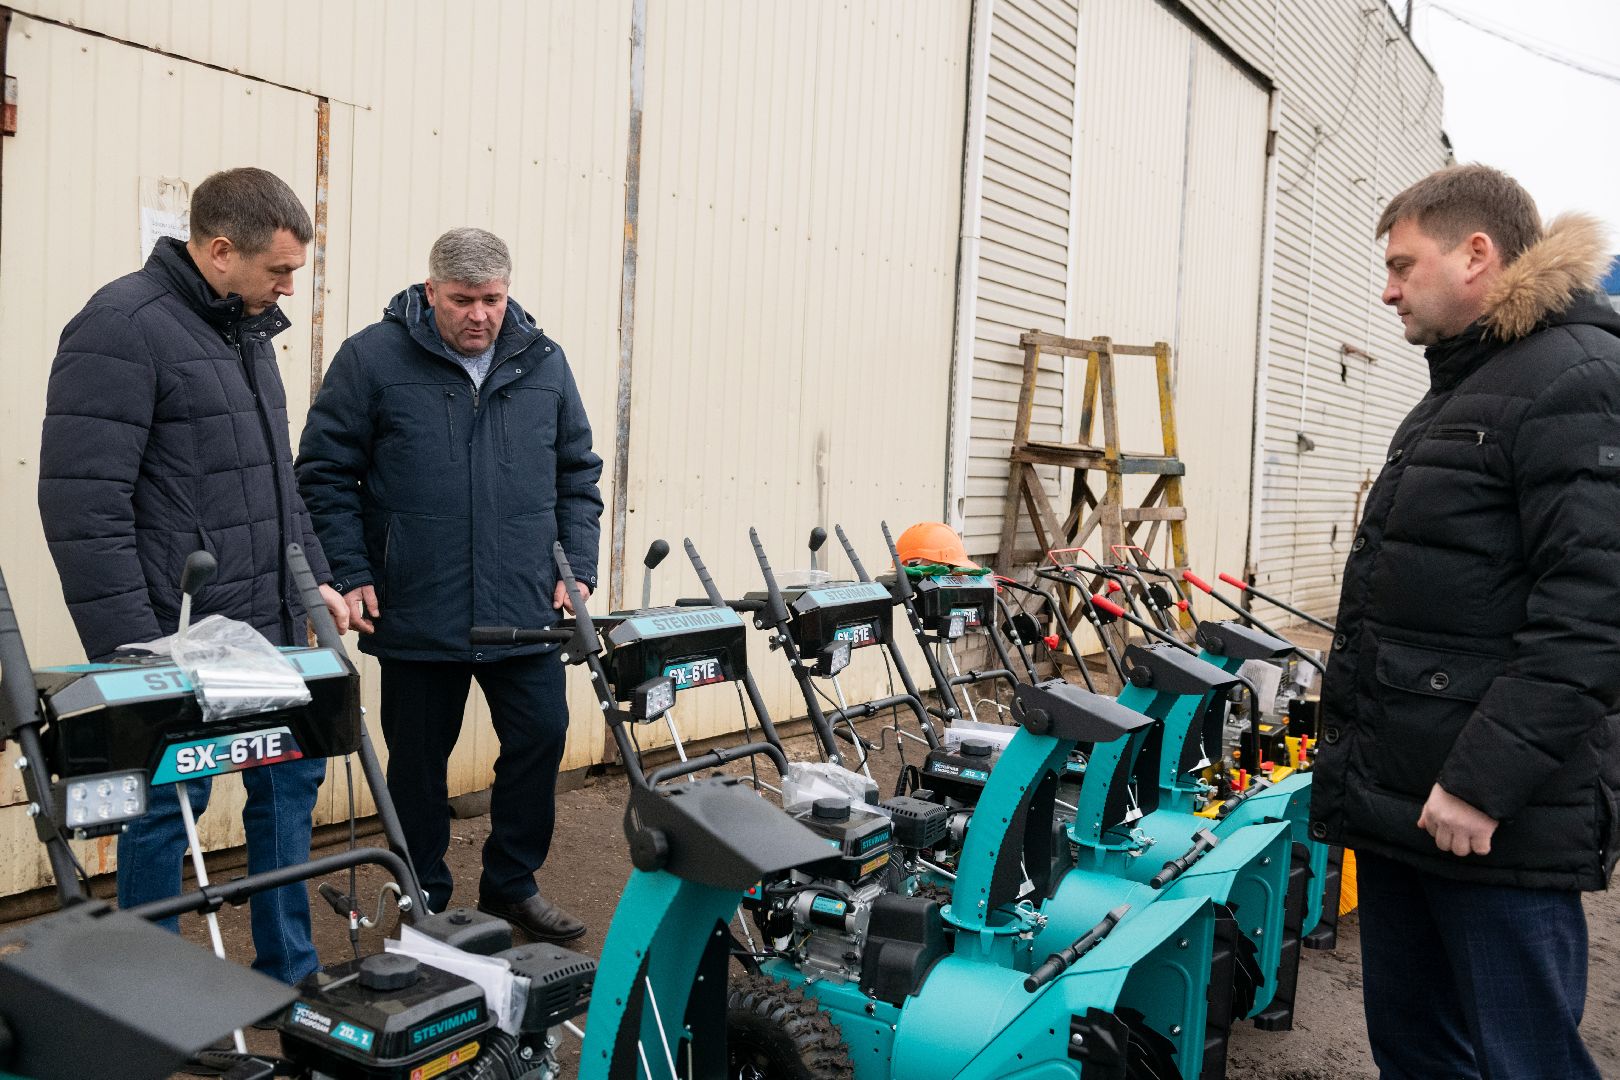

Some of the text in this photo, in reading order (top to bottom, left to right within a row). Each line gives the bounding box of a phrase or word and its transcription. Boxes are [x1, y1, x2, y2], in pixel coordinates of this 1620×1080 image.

[824, 586, 878, 601] STEVIMAN
[652, 611, 725, 631] STEVIMAN
[176, 732, 282, 774] SX-61E
[413, 1008, 478, 1044] STEVIMAN
